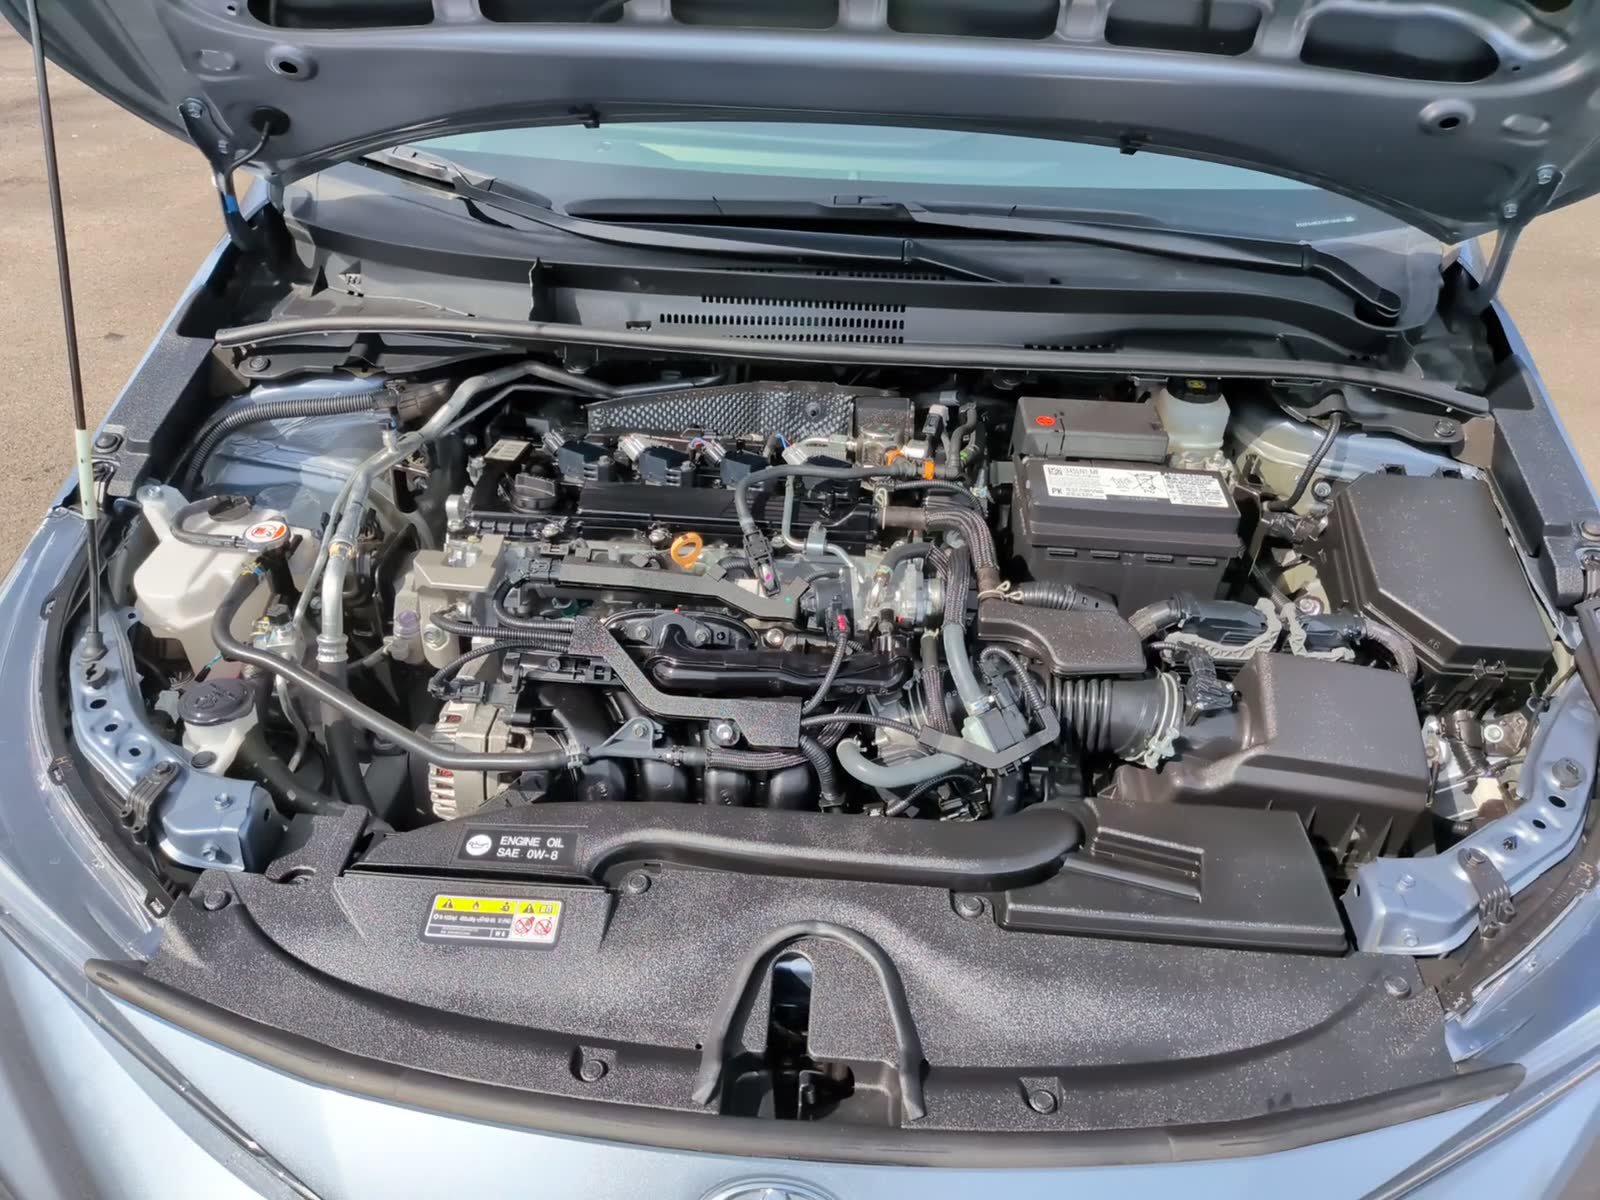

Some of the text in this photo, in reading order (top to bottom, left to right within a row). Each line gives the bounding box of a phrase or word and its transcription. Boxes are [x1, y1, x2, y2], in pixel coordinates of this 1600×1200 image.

[500, 835, 565, 849] ENGINE OIL
[496, 847, 559, 861] SAE 0W-8
